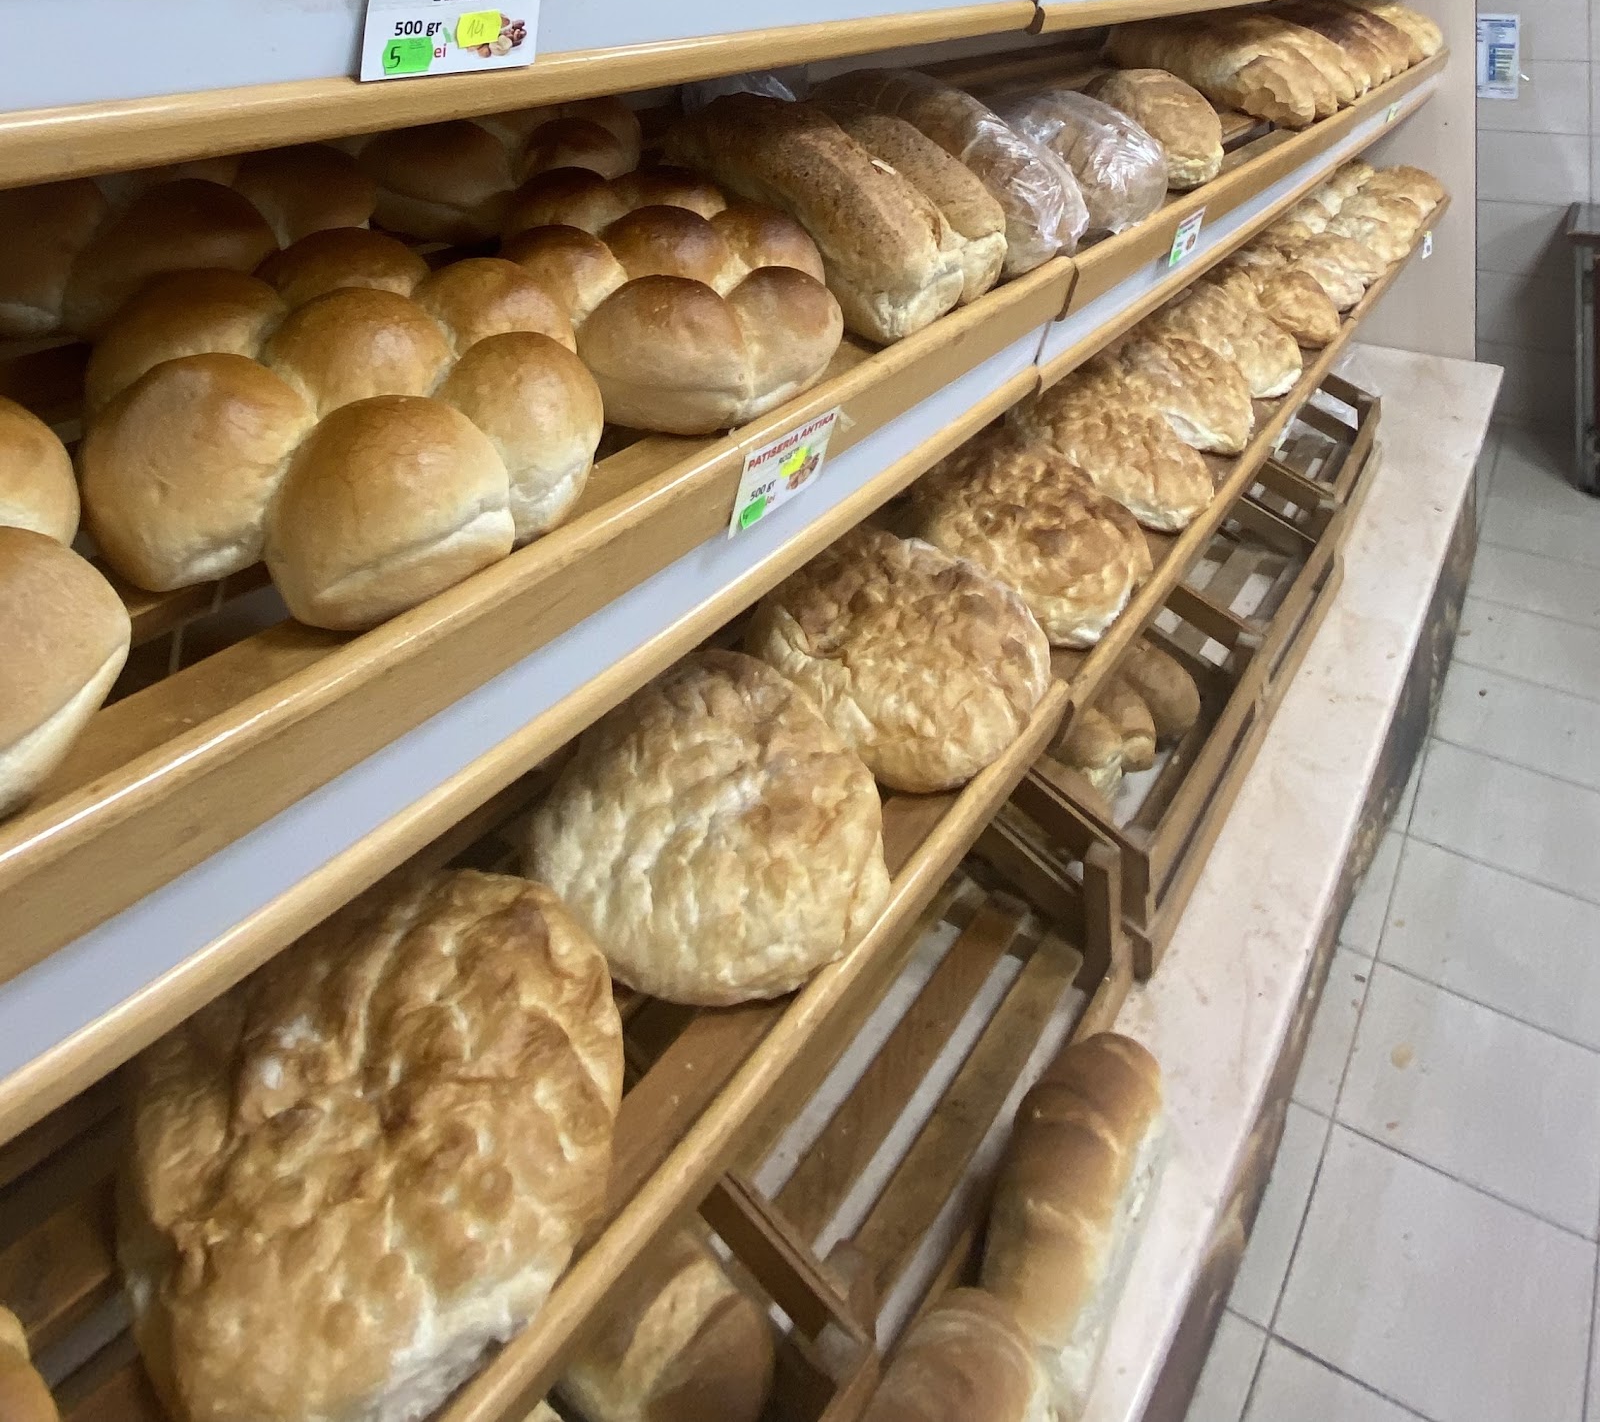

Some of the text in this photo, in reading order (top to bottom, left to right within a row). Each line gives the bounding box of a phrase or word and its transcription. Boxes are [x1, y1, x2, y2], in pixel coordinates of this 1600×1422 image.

[394, 20, 442, 37] 500 gr
[386, 45, 402, 69] 5
[433, 43, 447, 58] ei
[748, 434, 798, 471] PATISERIA
[800, 413, 835, 439] ANTIKA
